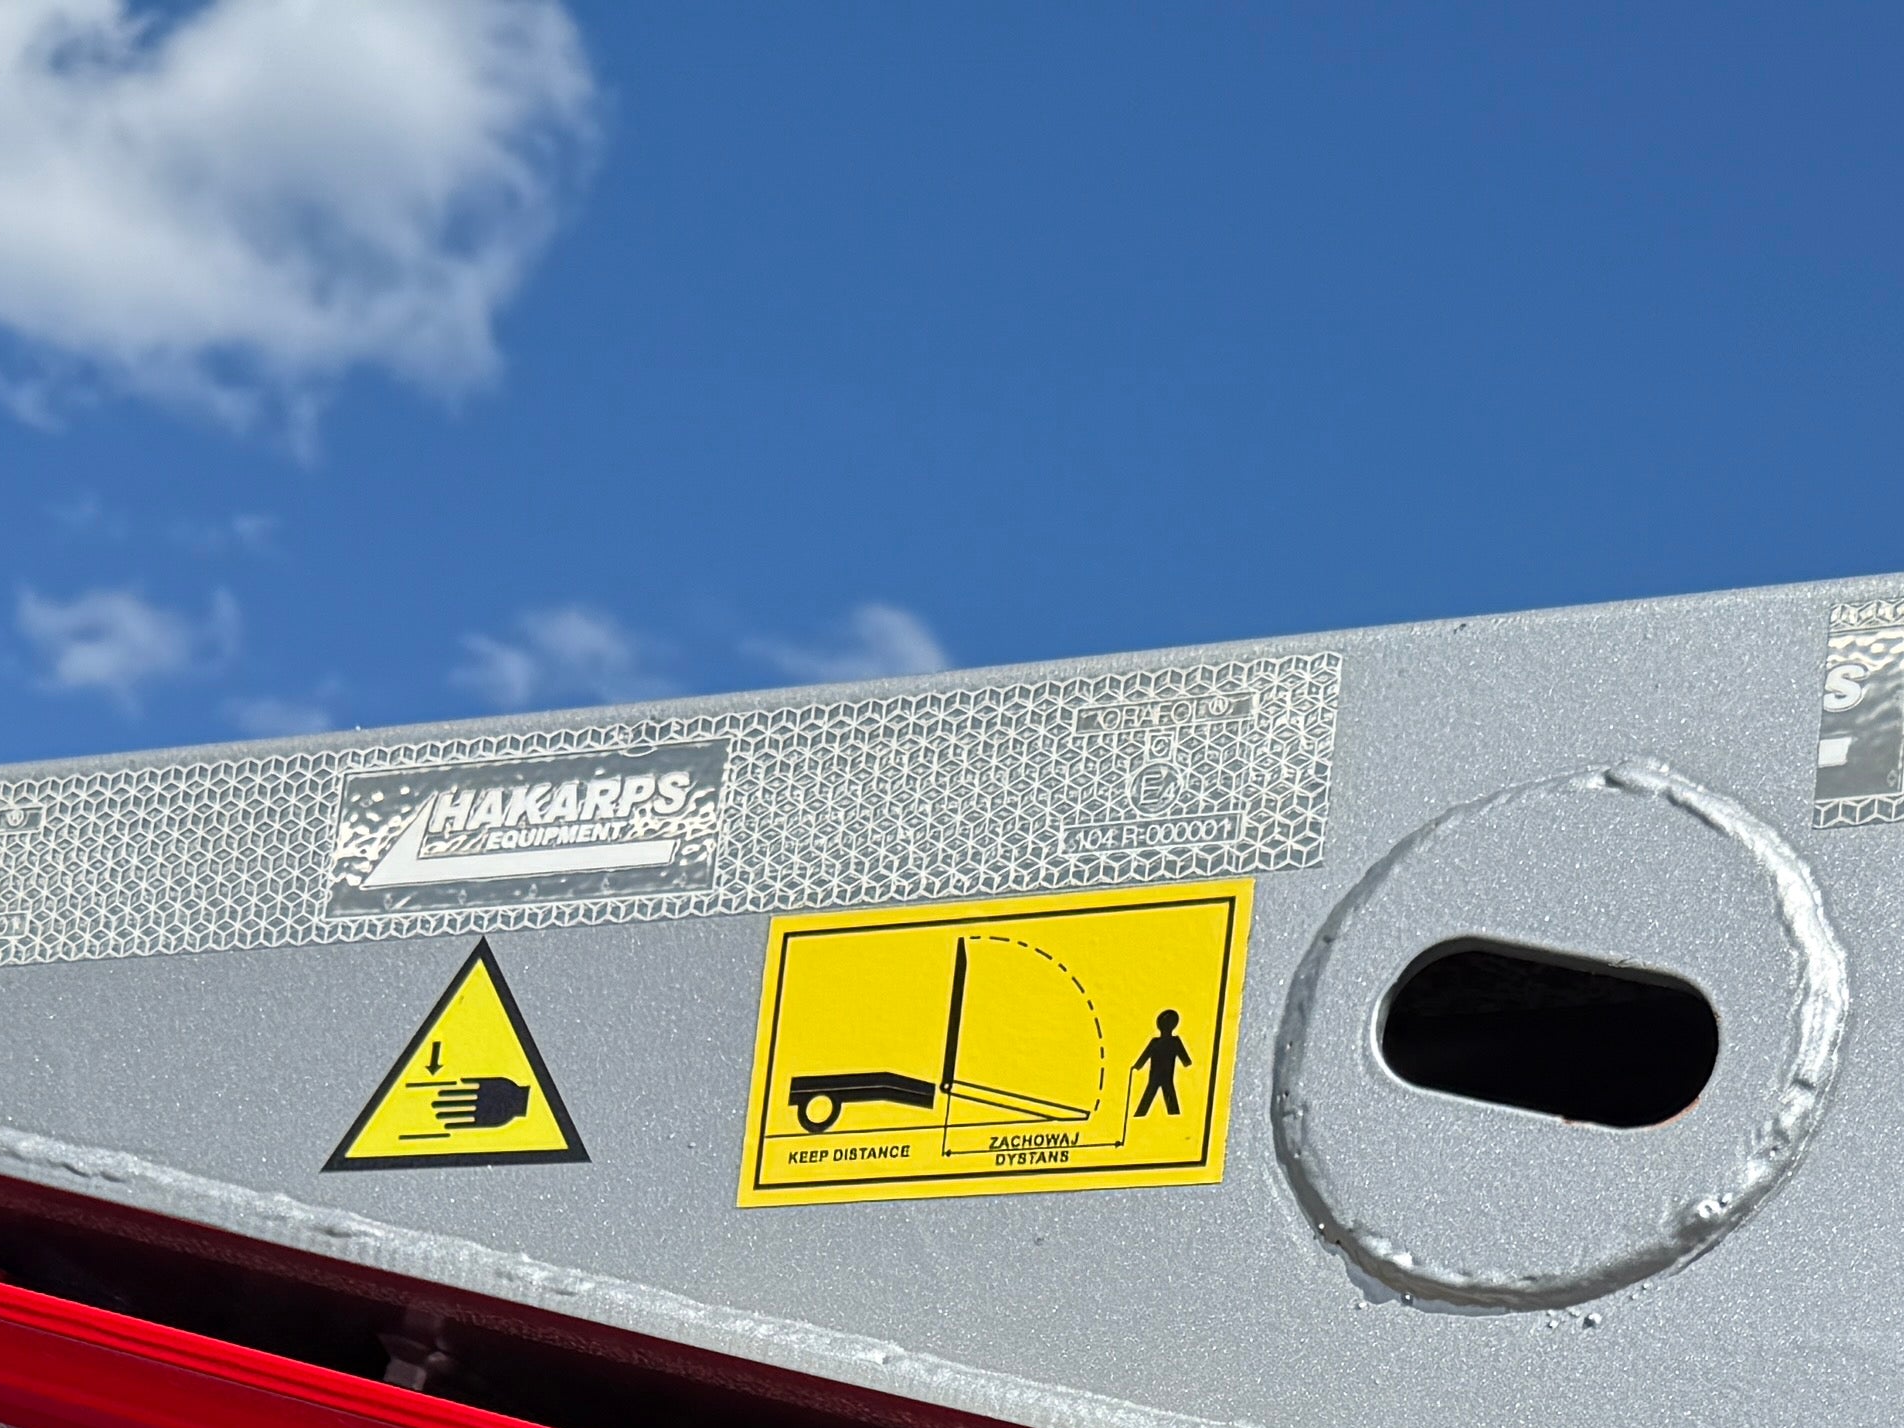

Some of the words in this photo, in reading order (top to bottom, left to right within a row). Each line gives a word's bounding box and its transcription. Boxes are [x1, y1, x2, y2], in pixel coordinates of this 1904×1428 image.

[428, 771, 691, 833] HAKARPS
[486, 821, 626, 850] EQUIPMENT
[989, 1132, 1080, 1150] ZACHOWAJ
[788, 1149, 829, 1164] KEEP
[833, 1145, 911, 1162] DISTANCE
[995, 1151, 1069, 1166] DYSTANS
